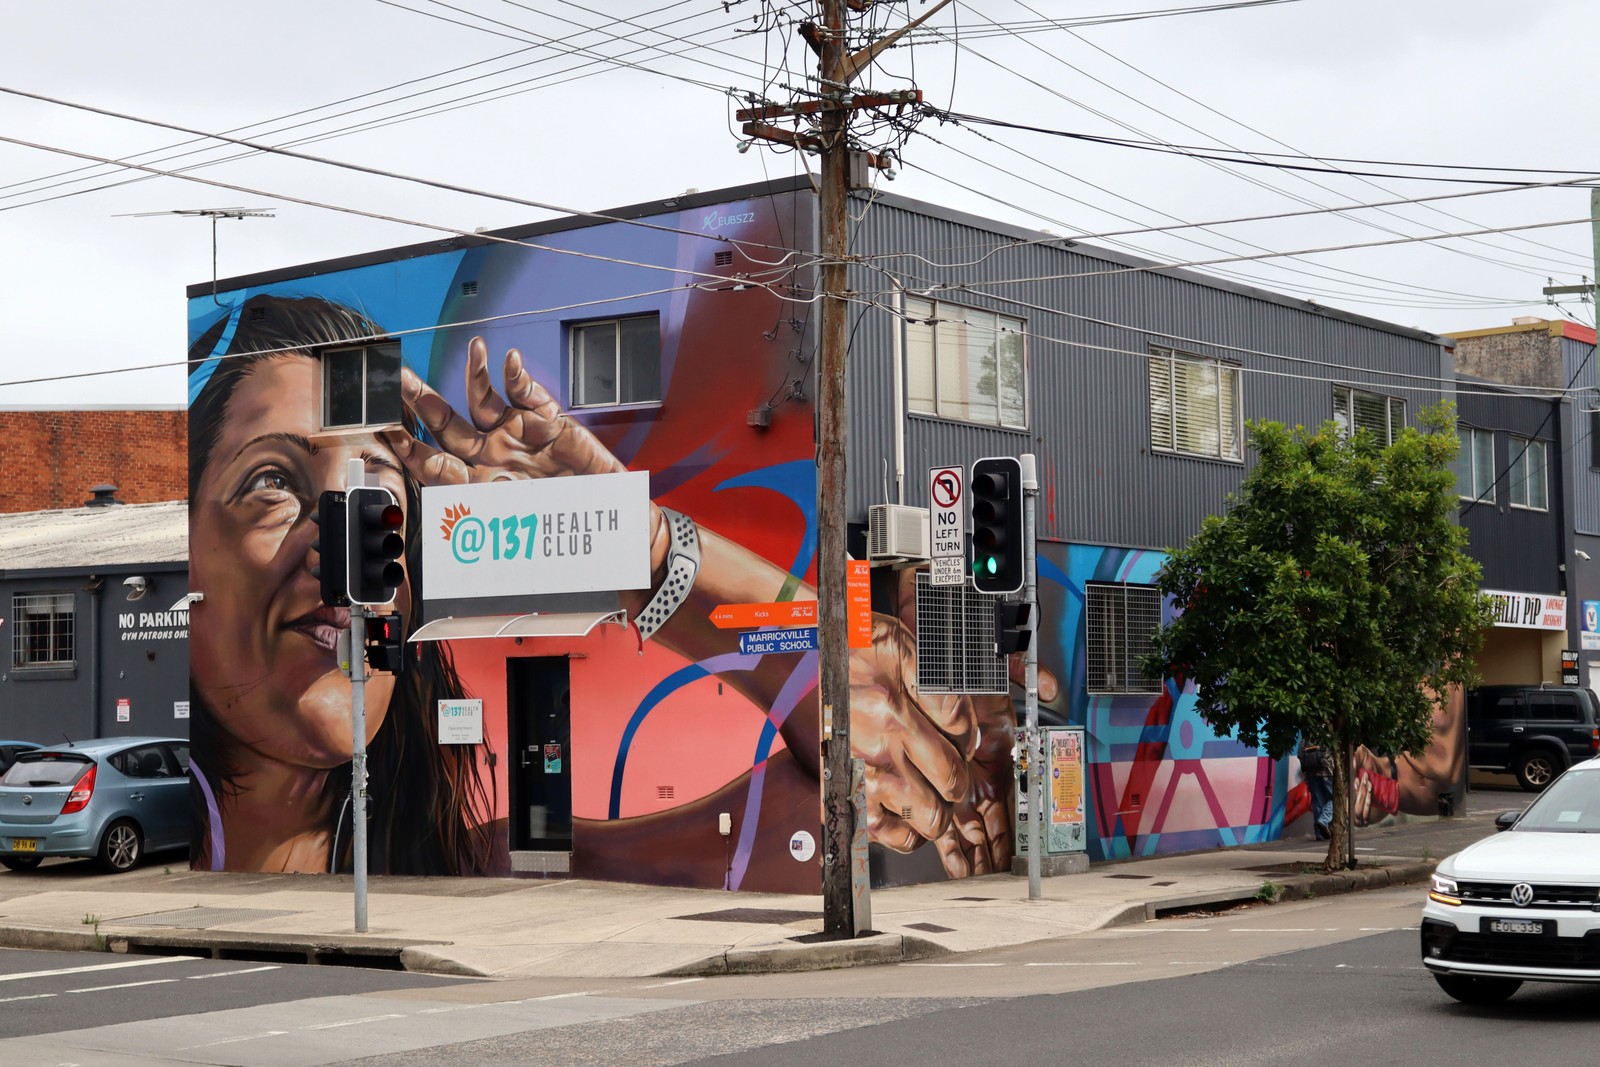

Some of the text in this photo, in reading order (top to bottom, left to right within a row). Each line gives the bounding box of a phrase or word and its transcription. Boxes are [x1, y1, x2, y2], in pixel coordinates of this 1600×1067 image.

[543, 509, 619, 535] HEALTH
[938, 511, 956, 525] NO
[452, 513, 538, 564] @137
[936, 529, 958, 539] LEFT
[543, 534, 592, 557] CLUB
[936, 541, 960, 551] TURN
[936, 559, 960, 567] VEHICLES
[935, 575, 961, 583] EXCEPTED
[1545, 598, 1565, 611] LOUNGE
[119, 613, 135, 628] NO
[1542, 614, 1563, 627] DESIGNS
[121, 630, 189, 641] GYM PATRONS ONL
[748, 629, 810, 643] MARRICKVILLE
[747, 640, 813, 653] PUBLIC SCHOOL
